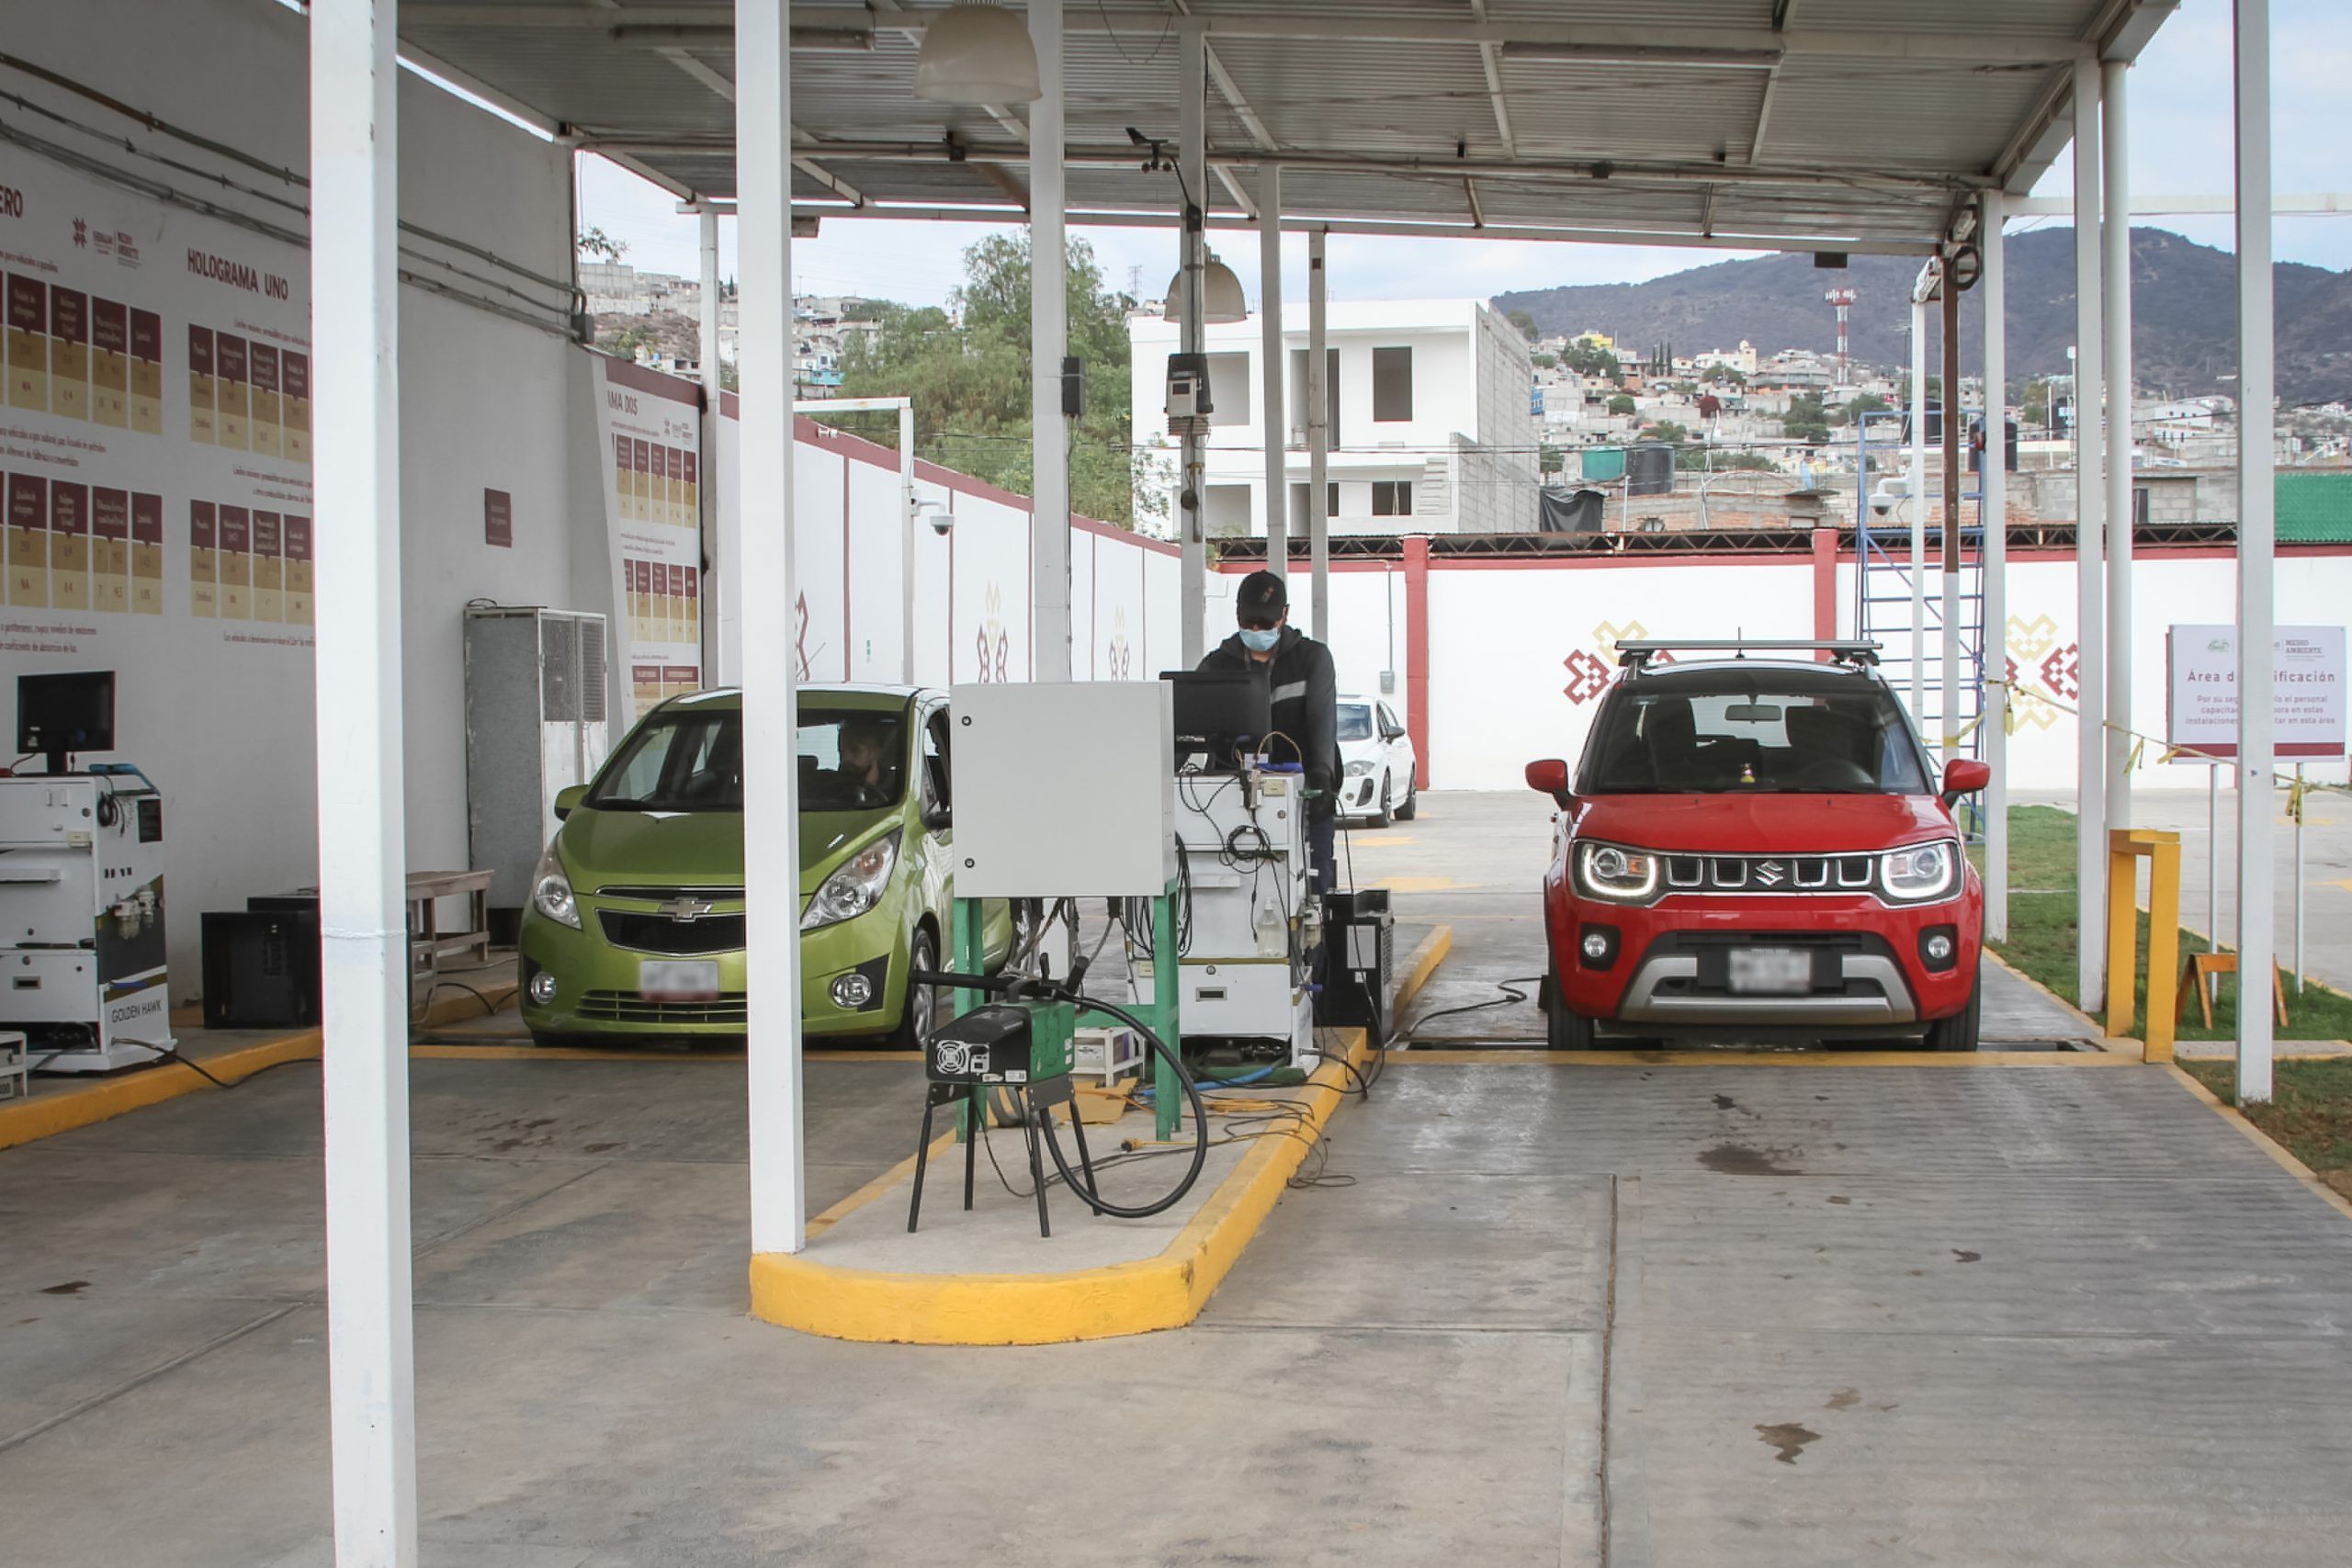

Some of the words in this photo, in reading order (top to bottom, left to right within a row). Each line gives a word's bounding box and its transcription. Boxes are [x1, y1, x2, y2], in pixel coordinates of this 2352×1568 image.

[187, 248, 259, 294] HOLOGRAMA
[265, 273, 288, 301] UNO
[2187, 669, 2221, 682] Área
[2273, 670, 2335, 682] ificación
[111, 1004, 141, 1023] GOLDEN
[141, 999, 162, 1015] HAWK
